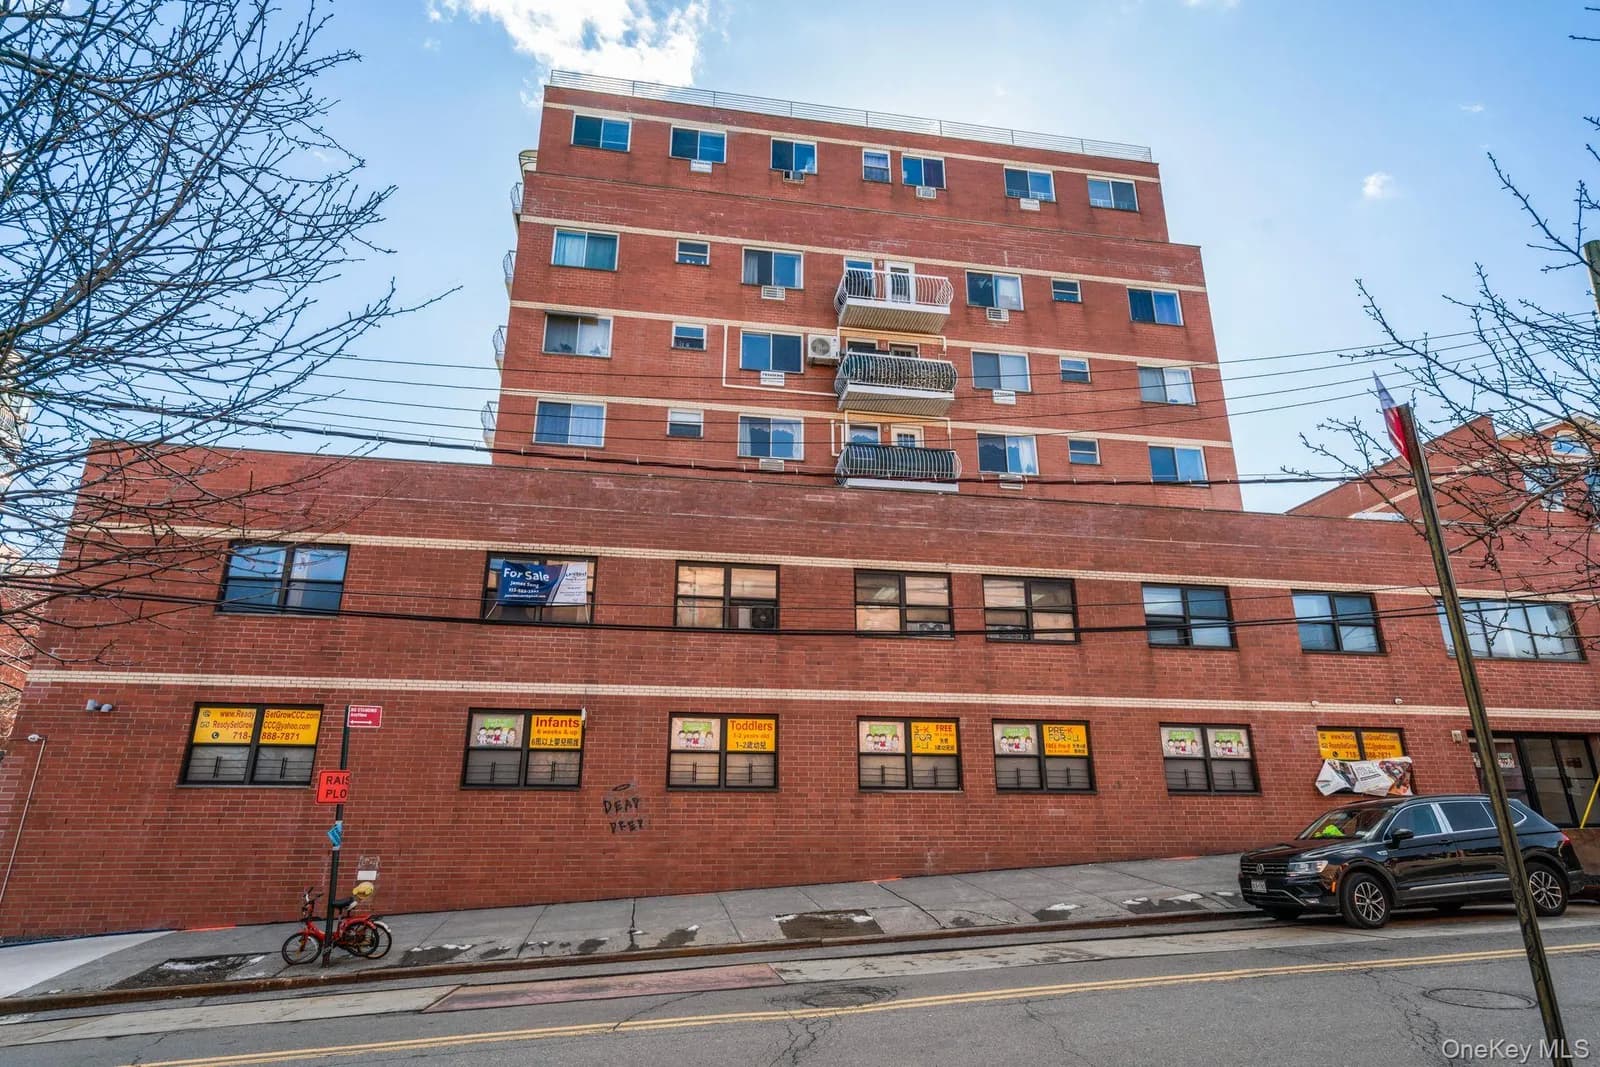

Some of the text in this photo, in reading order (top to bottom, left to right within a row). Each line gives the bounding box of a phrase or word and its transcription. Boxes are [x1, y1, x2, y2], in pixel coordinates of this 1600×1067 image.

[503, 568, 550, 582] For Sale
[535, 717, 580, 728] Infants
[729, 720, 773, 731] Toddlers
[936, 724, 953, 732] FREE
[1048, 726, 1073, 734] PRE-K
[261, 732, 300, 740] 888-7871
[913, 733, 932, 742] FOR
[1049, 733, 1066, 742] FOR
[325, 788, 347, 799] PLO
